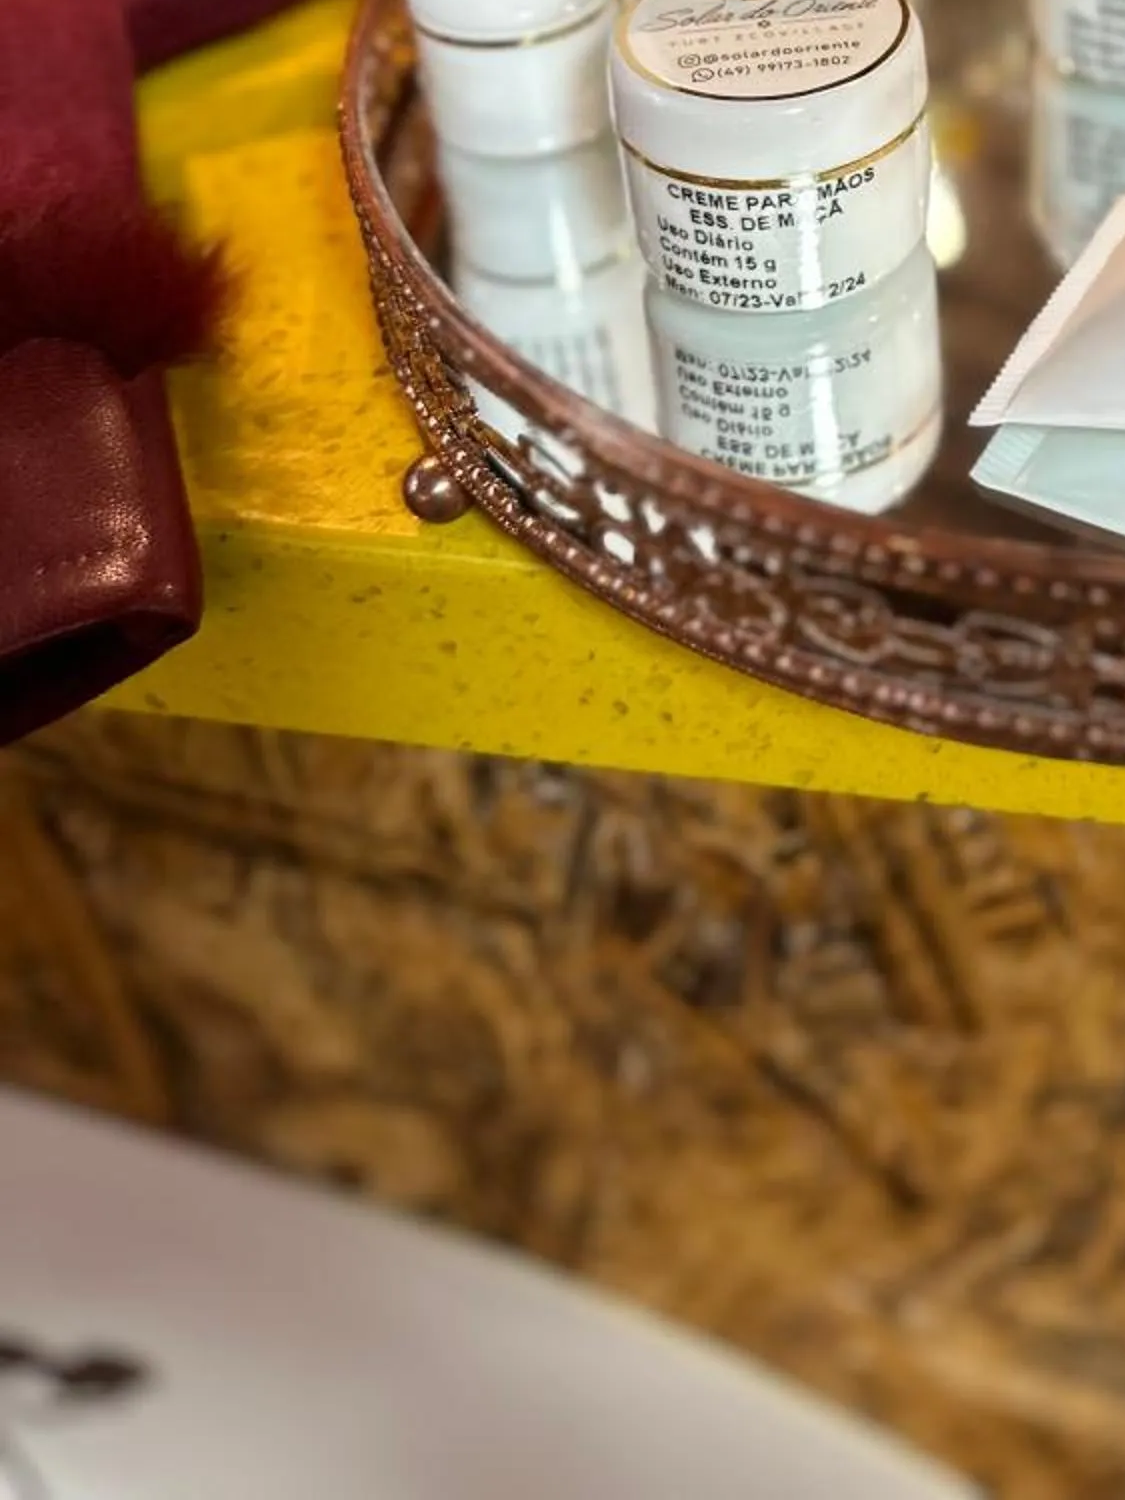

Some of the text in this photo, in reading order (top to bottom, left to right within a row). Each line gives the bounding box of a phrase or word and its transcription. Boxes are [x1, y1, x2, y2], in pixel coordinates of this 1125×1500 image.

[637, 2, 734, 32] Solar
[739, 0, 776, 22] do
[703, 39, 861, 65] @solardooriente
[717, 56, 850, 79] (49) 99173-1802
[667, 182, 739, 211] CREME
[746, 192, 798, 211] PAR
[657, 216, 754, 252] Uso Diário
[690, 208, 734, 231] ESS.
[741, 216, 772, 231] DE
[660, 235, 777, 273] Contém 15 g
[662, 256, 778, 289] Uso Externo
[709, 291, 806, 308] 07/23-Val
[818, 271, 866, 298] 2/24
